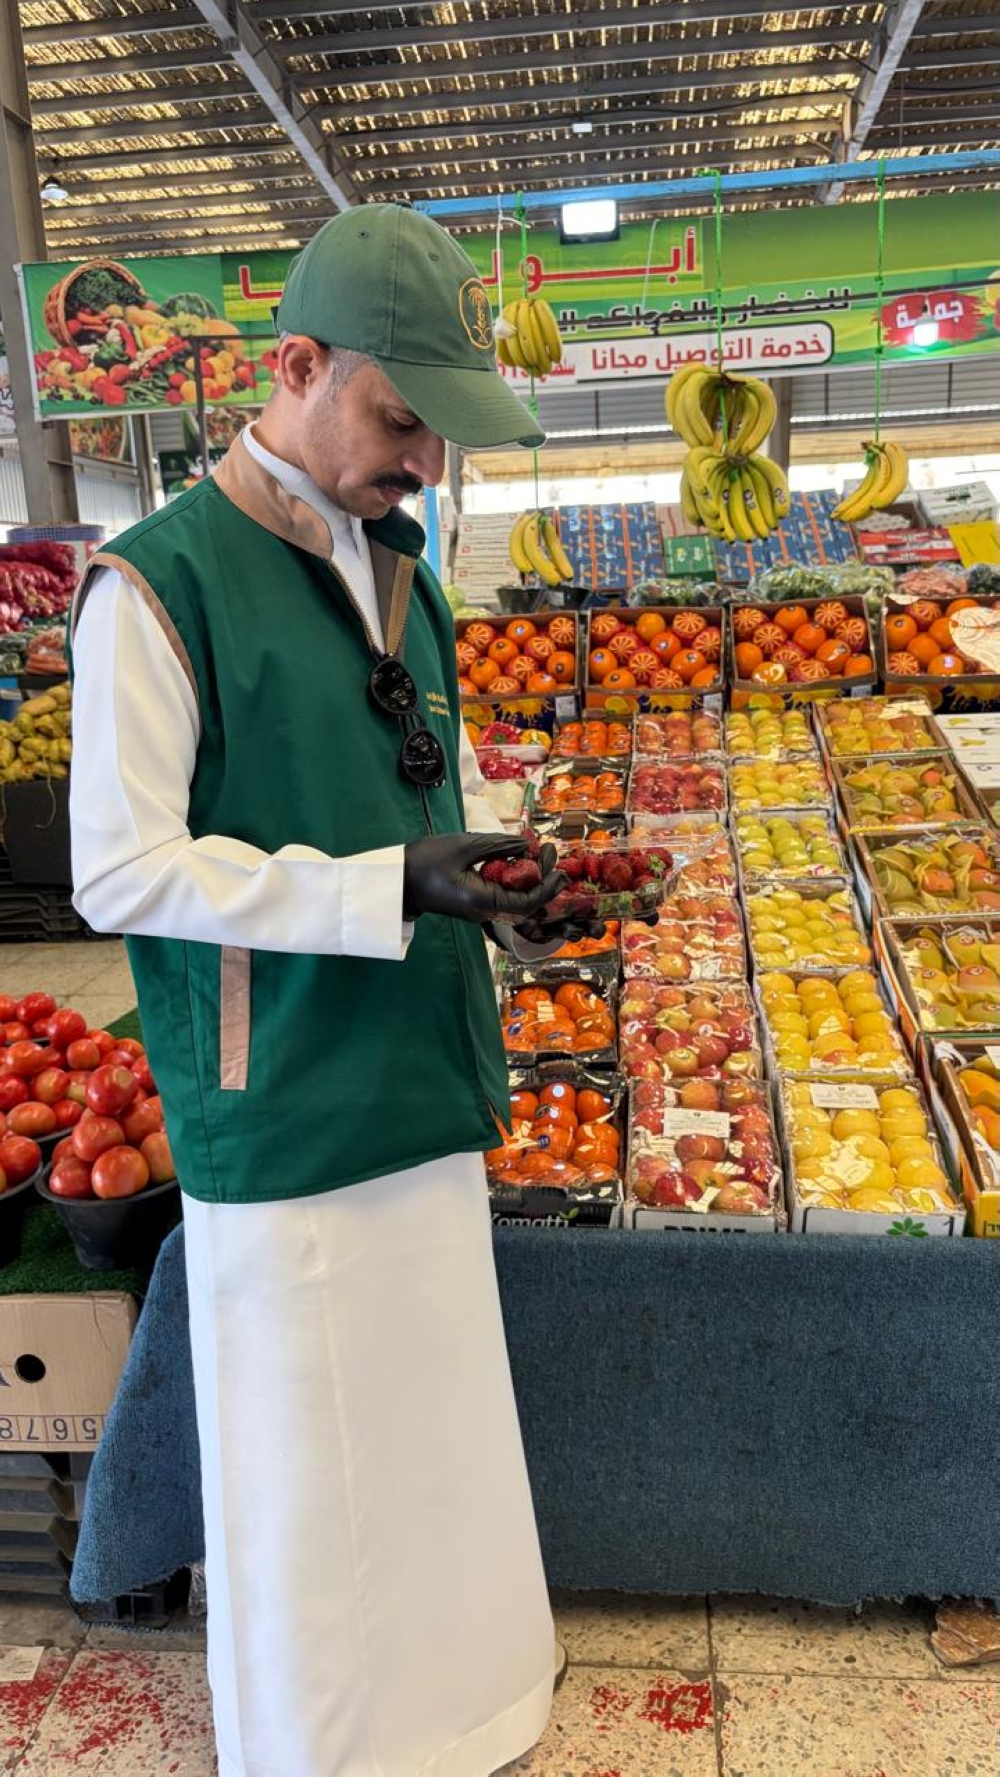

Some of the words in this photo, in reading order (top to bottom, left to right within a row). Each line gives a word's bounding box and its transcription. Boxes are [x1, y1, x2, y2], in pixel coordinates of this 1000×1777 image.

[656, 337, 752, 371] التوصيل
[761, 334, 825, 358] خدمة
[592, 347, 647, 374] مجانا
[26, 1418, 40, 1440] 7
[52, 1418, 68, 1440] 6
[82, 1418, 97, 1440] 5
